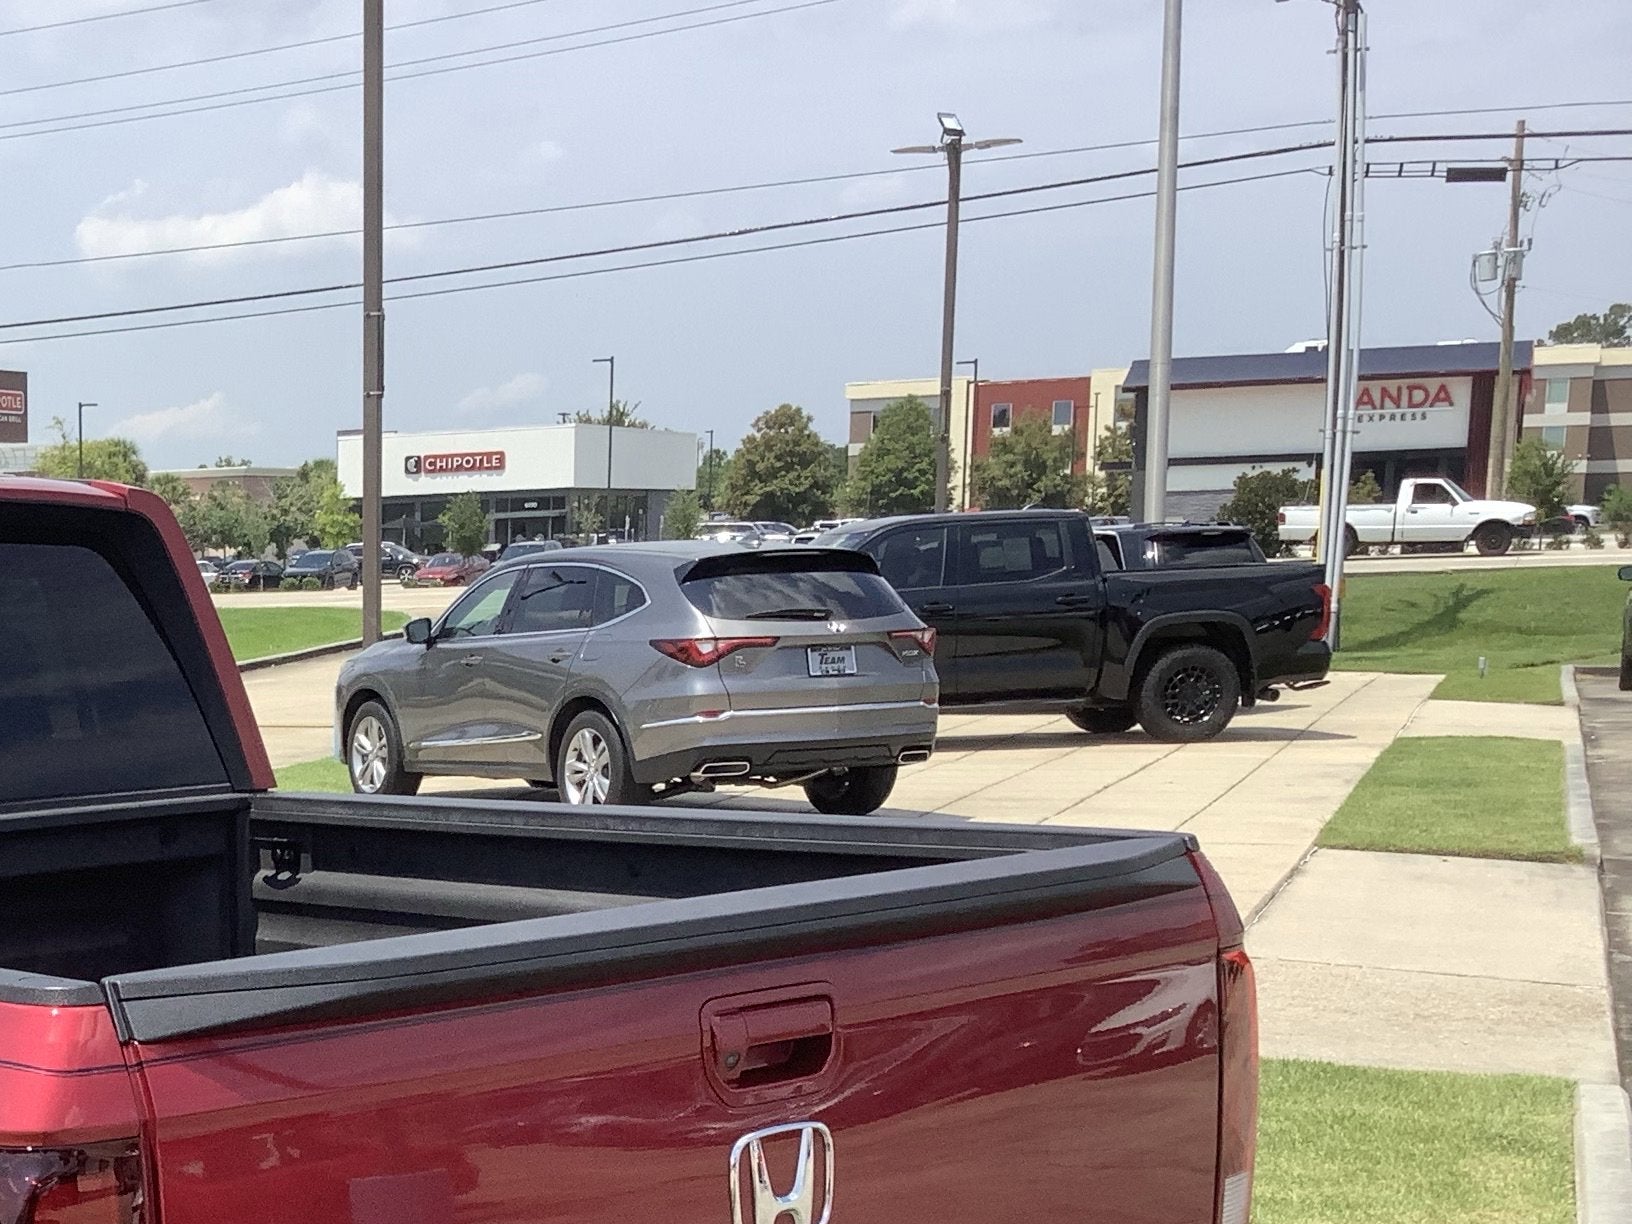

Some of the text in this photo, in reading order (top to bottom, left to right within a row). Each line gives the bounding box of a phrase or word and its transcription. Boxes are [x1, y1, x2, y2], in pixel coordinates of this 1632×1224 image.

[1356, 384, 1454, 410] ANDA
[1358, 411, 1428, 423] EXPRESS
[425, 455, 502, 470] CHIPOTLE
[818, 652, 845, 665] TEAM
